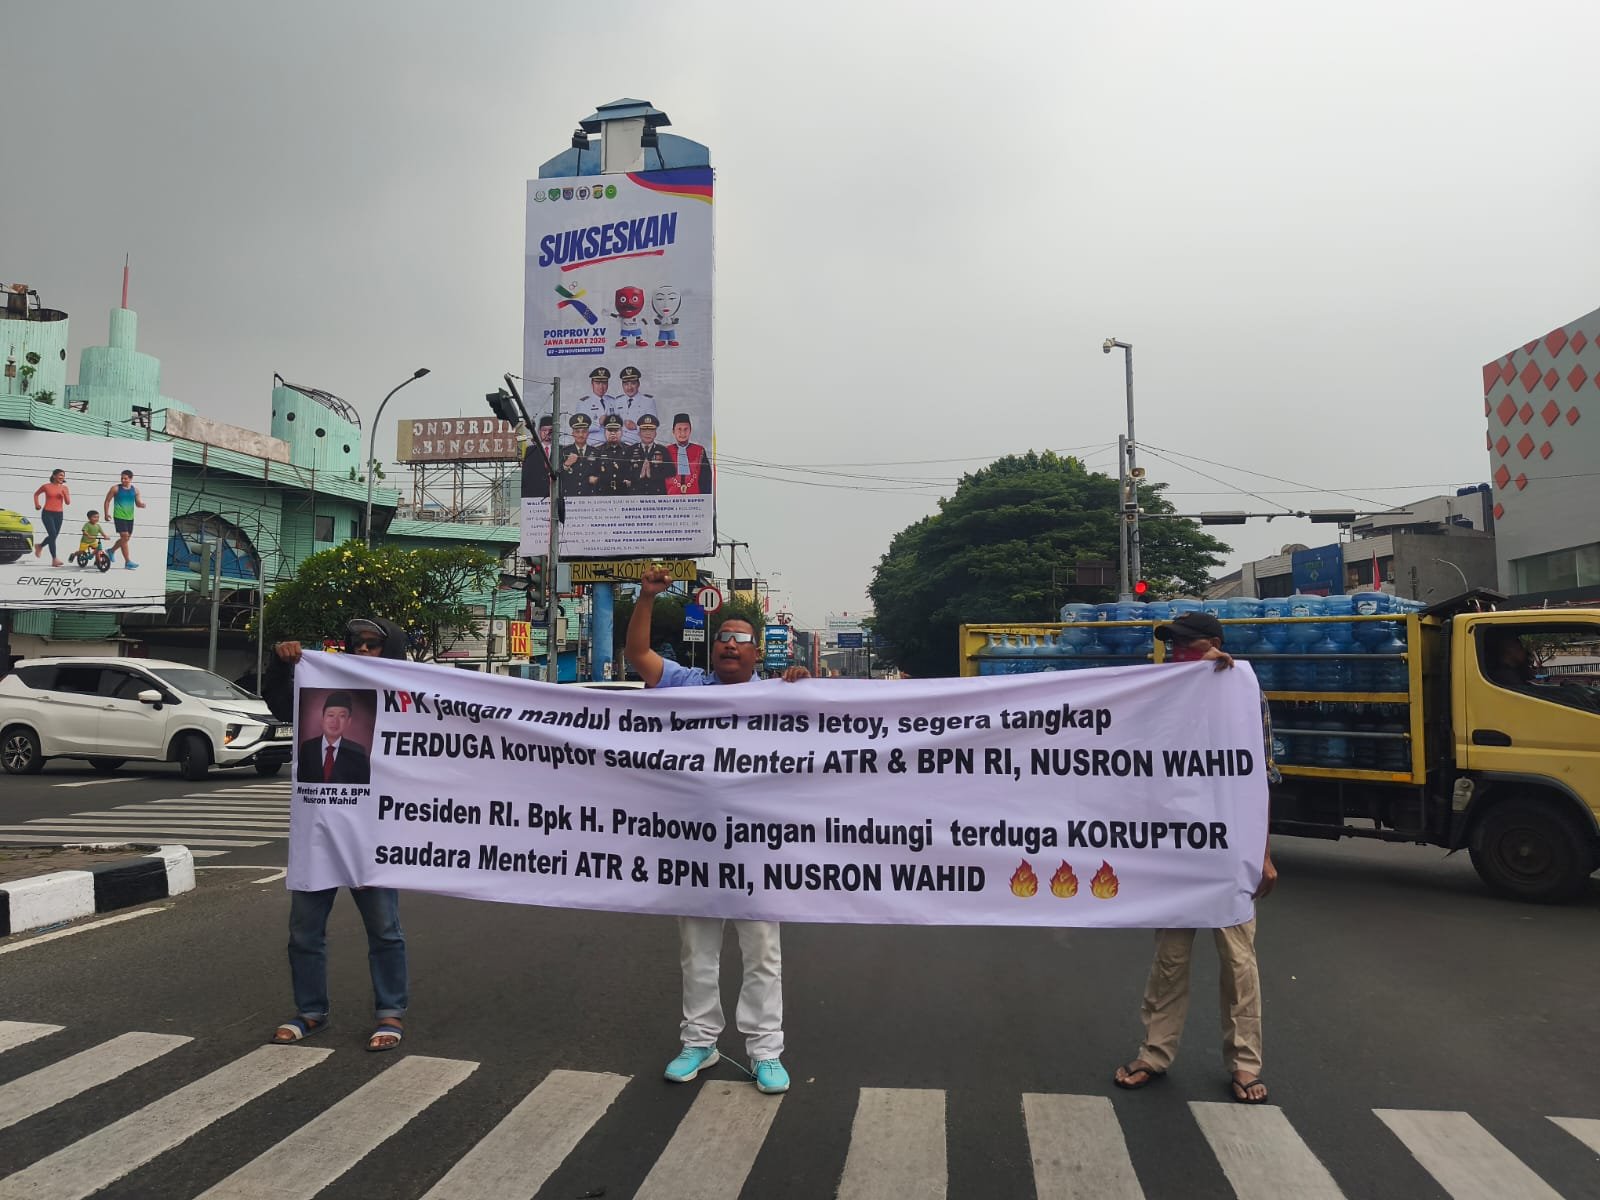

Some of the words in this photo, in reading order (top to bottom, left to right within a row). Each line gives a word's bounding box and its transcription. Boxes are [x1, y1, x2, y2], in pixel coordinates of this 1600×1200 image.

[538, 212, 677, 268] SUKSESKAN
[544, 329, 589, 338] PORPROV
[593, 328, 606, 336] XV
[413, 420, 517, 436] ONDERDIL
[423, 439, 516, 455] BENGKEL
[17, 576, 82, 587] ENERGY
[44, 586, 61, 596] IN
[64, 587, 126, 598] MOTION
[383, 689, 431, 714] KPK
[433, 694, 512, 723] jangan
[518, 707, 610, 731] mandul
[619, 709, 663, 732] dan
[818, 713, 889, 739] letoy,
[898, 713, 991, 735] segera
[1000, 704, 1112, 735] tangkap
[381, 731, 495, 760] TERDUGA
[501, 737, 597, 769] koruptor
[605, 748, 705, 772] saudara
[714, 747, 815, 774] Menteri
[823, 749, 878, 774] ATR
[887, 751, 907, 774] &
[917, 748, 974, 774] BPN
[984, 748, 1021, 781] RI,
[1031, 749, 1153, 777] NUSRON
[1163, 750, 1254, 777] WAHID
[296, 786, 318, 795] Menteri
[320, 788, 338, 796] ATR
[340, 788, 348, 796] &
[351, 788, 370, 796] BPN
[303, 796, 326, 805] Nusron
[329, 797, 358, 805] Wahid
[378, 795, 481, 825] Presiden
[489, 801, 519, 827] RI.
[528, 803, 572, 835] Bpk
[580, 806, 604, 833] H.
[612, 808, 717, 842] Prabowo
[724, 816, 816, 850] jangan
[825, 817, 932, 852] lindungi
[950, 820, 1058, 854] terduga
[1067, 821, 1229, 849] KORUPTOR
[375, 842, 470, 869] saudara
[478, 845, 567, 876] Menteri
[575, 850, 622, 880] ATR
[631, 856, 648, 882] &
[658, 858, 709, 887] BPN
[718, 863, 754, 896] RI,
[763, 863, 881, 891] NUSRON
[891, 864, 986, 892] WAHID
